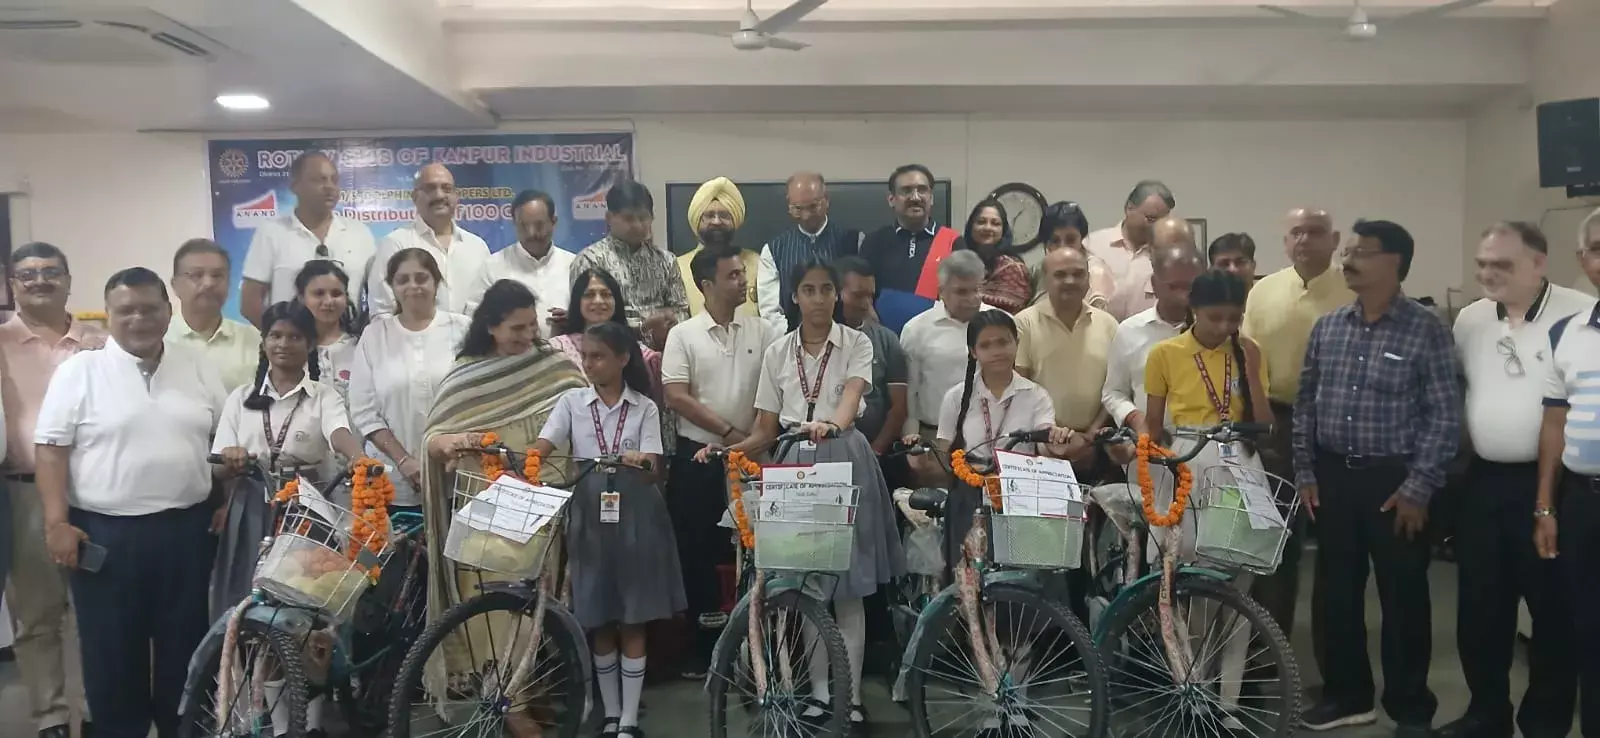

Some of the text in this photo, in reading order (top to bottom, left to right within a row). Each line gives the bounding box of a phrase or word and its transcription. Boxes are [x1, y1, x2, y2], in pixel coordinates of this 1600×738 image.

[257, 149, 337, 169] ROTY
[397, 147, 430, 166] OF
[432, 147, 511, 165] KANPUR
[513, 143, 628, 163] INDUSTRIAL
[344, 208, 417, 222] Distribut
